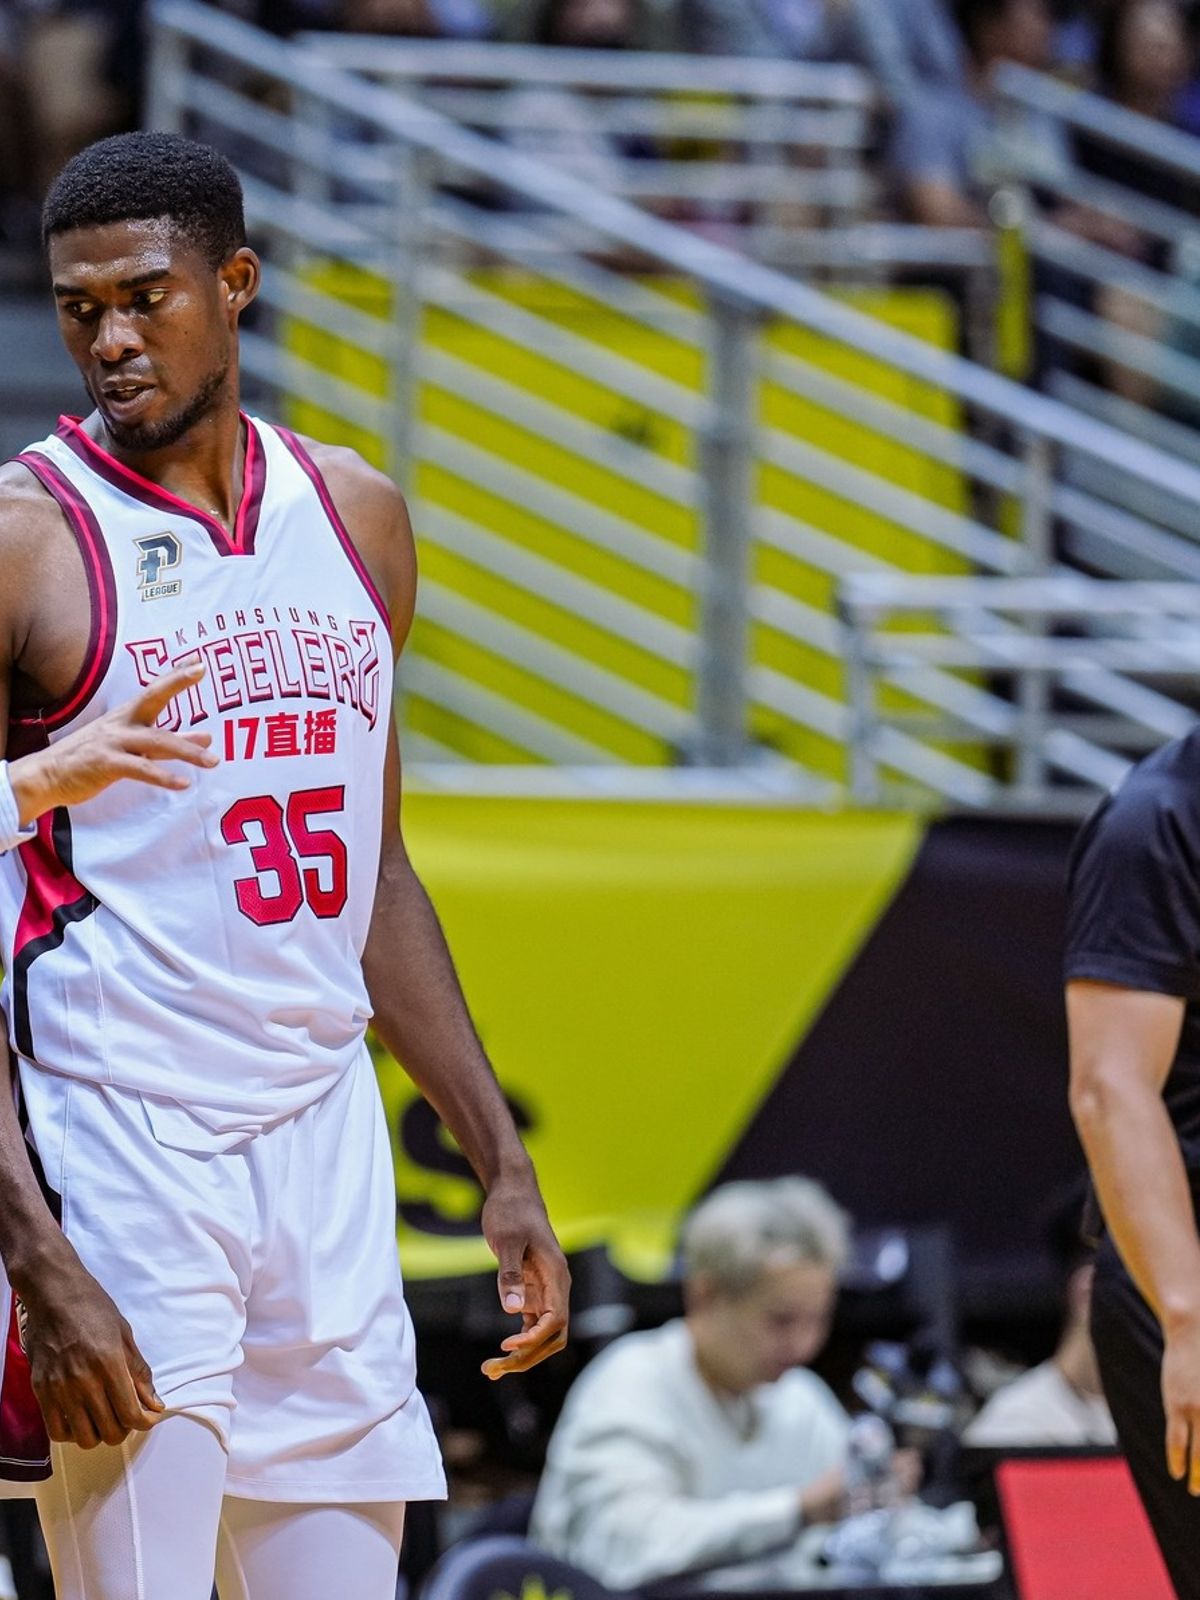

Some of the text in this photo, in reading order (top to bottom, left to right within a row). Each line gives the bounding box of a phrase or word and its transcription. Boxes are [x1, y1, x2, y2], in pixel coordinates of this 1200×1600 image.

[144, 582, 179, 599] LEAGUE
[175, 607, 338, 647] KAOHSIUNG
[224, 708, 338, 762] 17直播
[220, 785, 348, 926] 35
